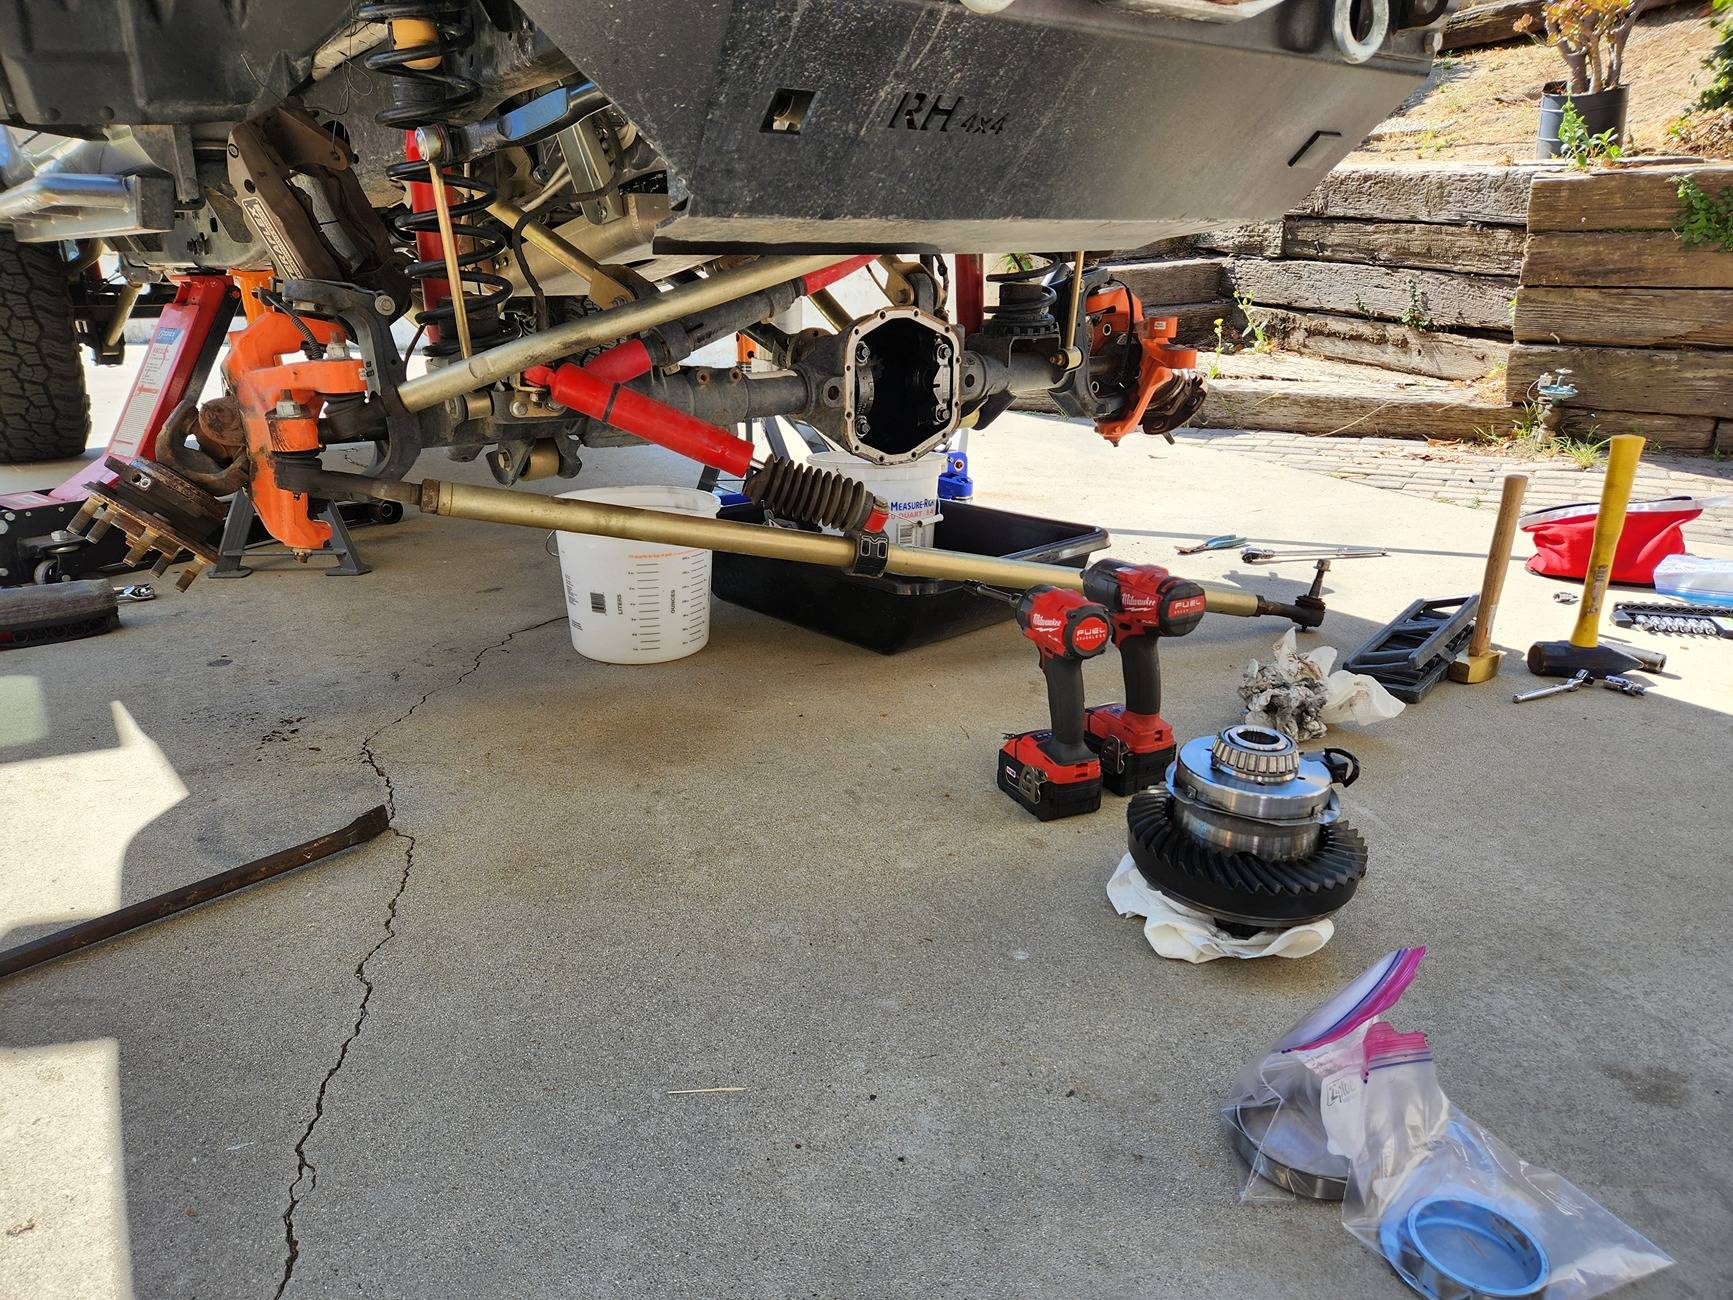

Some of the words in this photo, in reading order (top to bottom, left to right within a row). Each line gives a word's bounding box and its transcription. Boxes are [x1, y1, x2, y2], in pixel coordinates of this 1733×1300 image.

[888, 92, 963, 132] RH
[961, 111, 1010, 135] 4x4
[1122, 592, 1156, 607] Milwaukee
[1174, 599, 1201, 610] FUEL
[1033, 613, 1062, 627] Milwaukee
[1076, 627, 1106, 637] FUEL
